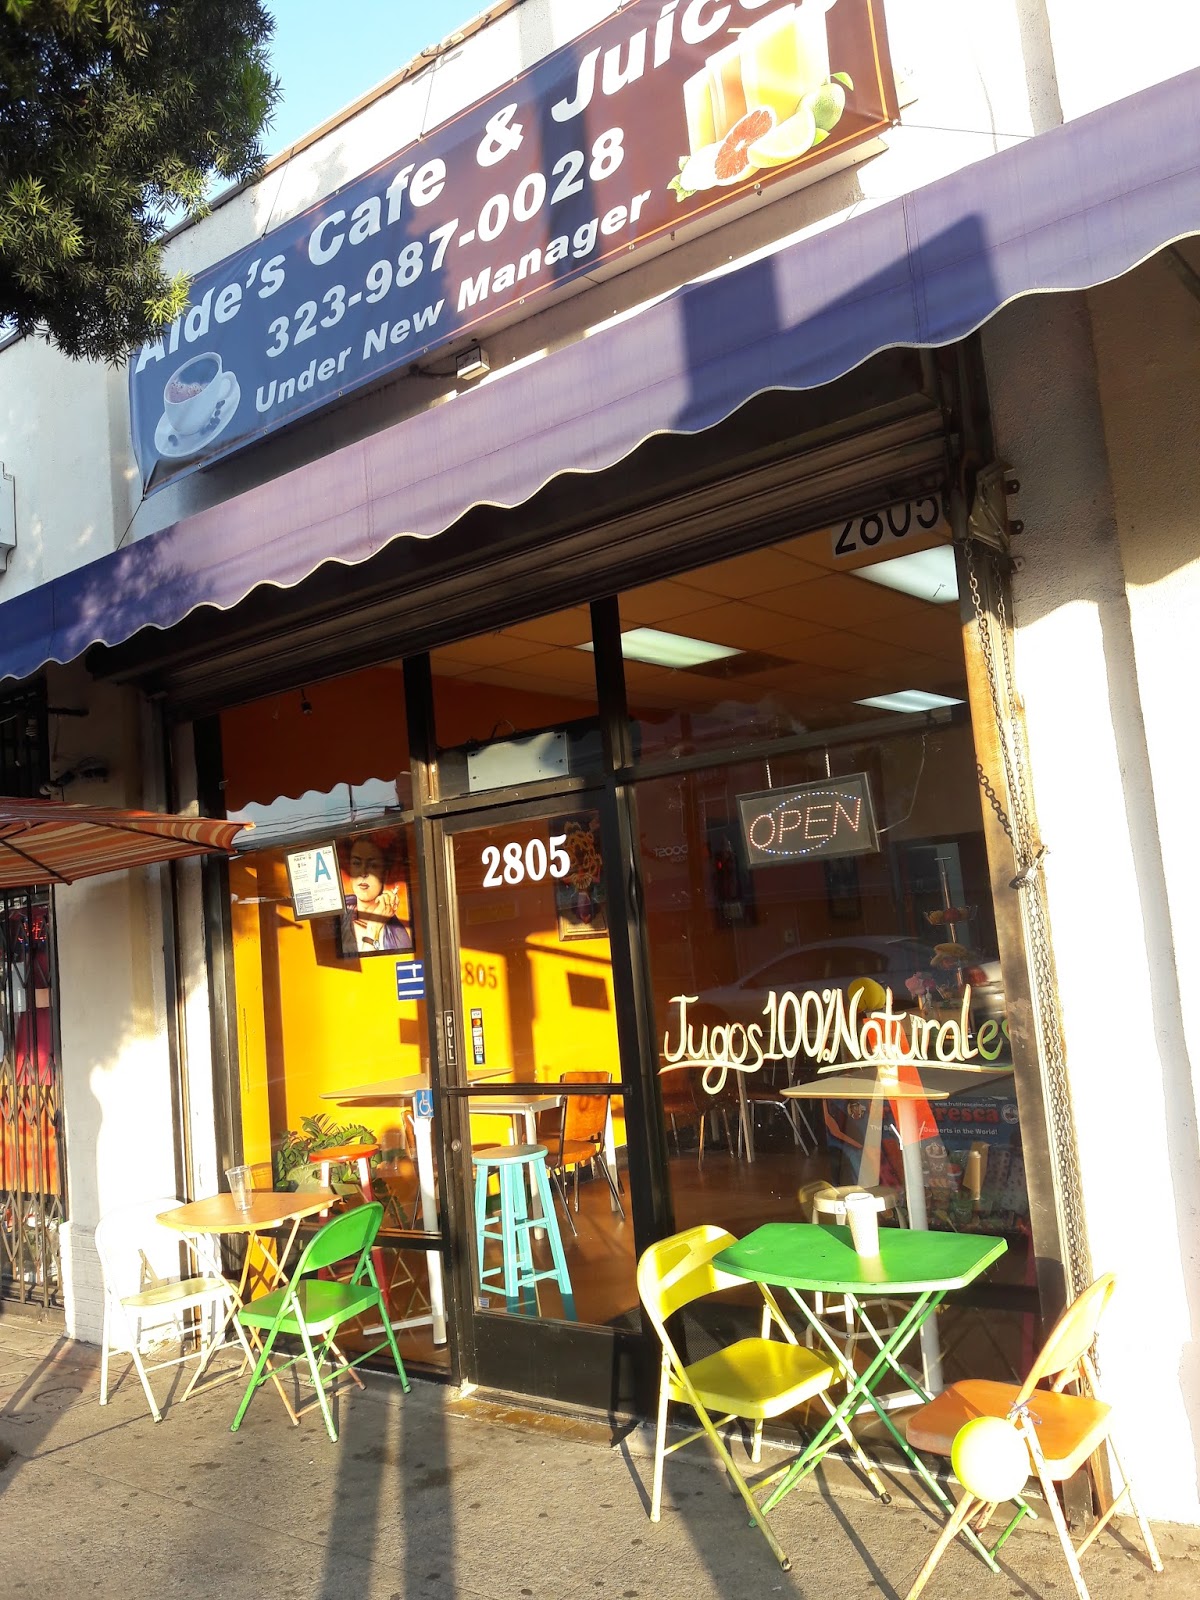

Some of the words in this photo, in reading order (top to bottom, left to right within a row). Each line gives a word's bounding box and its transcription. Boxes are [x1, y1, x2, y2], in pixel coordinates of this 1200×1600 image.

[308, 157, 446, 266] Cafe
[476, 103, 524, 167] &
[551, 0, 771, 122] Juic
[266, 127, 625, 358] 323-987-0028
[255, 345, 352, 414] Under
[363, 299, 445, 360] New
[457, 190, 651, 314] Manager
[482, 834, 571, 888] 2805
[749, 798, 861, 849] OPEN
[315, 851, 331, 883] A
[446, 1016, 454, 1059] PULL
[664, 994, 764, 1095] Jugos
[763, 988, 832, 1062] 100%
